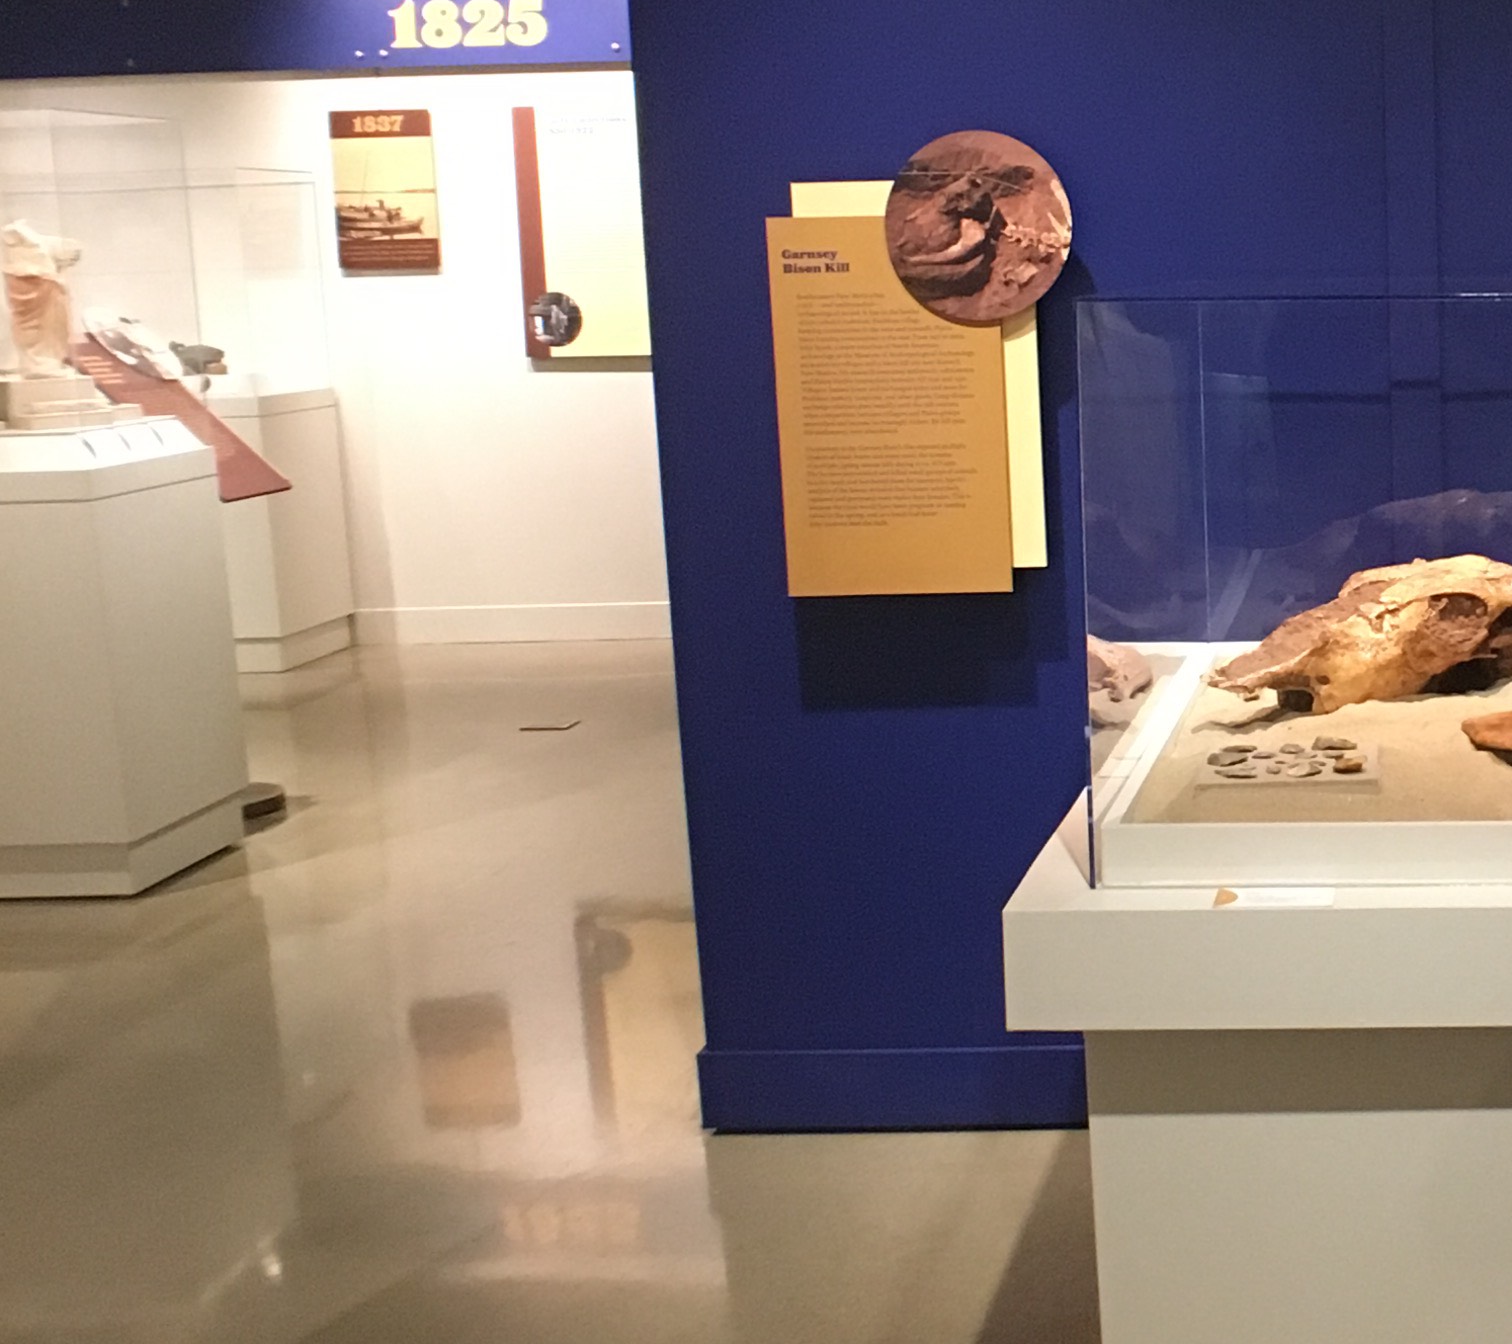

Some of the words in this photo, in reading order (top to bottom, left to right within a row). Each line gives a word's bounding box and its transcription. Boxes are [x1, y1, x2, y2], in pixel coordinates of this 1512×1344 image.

[352, 115, 404, 132] 1837
[783, 263, 821, 273] Bison
[824, 262, 850, 273] Kill
